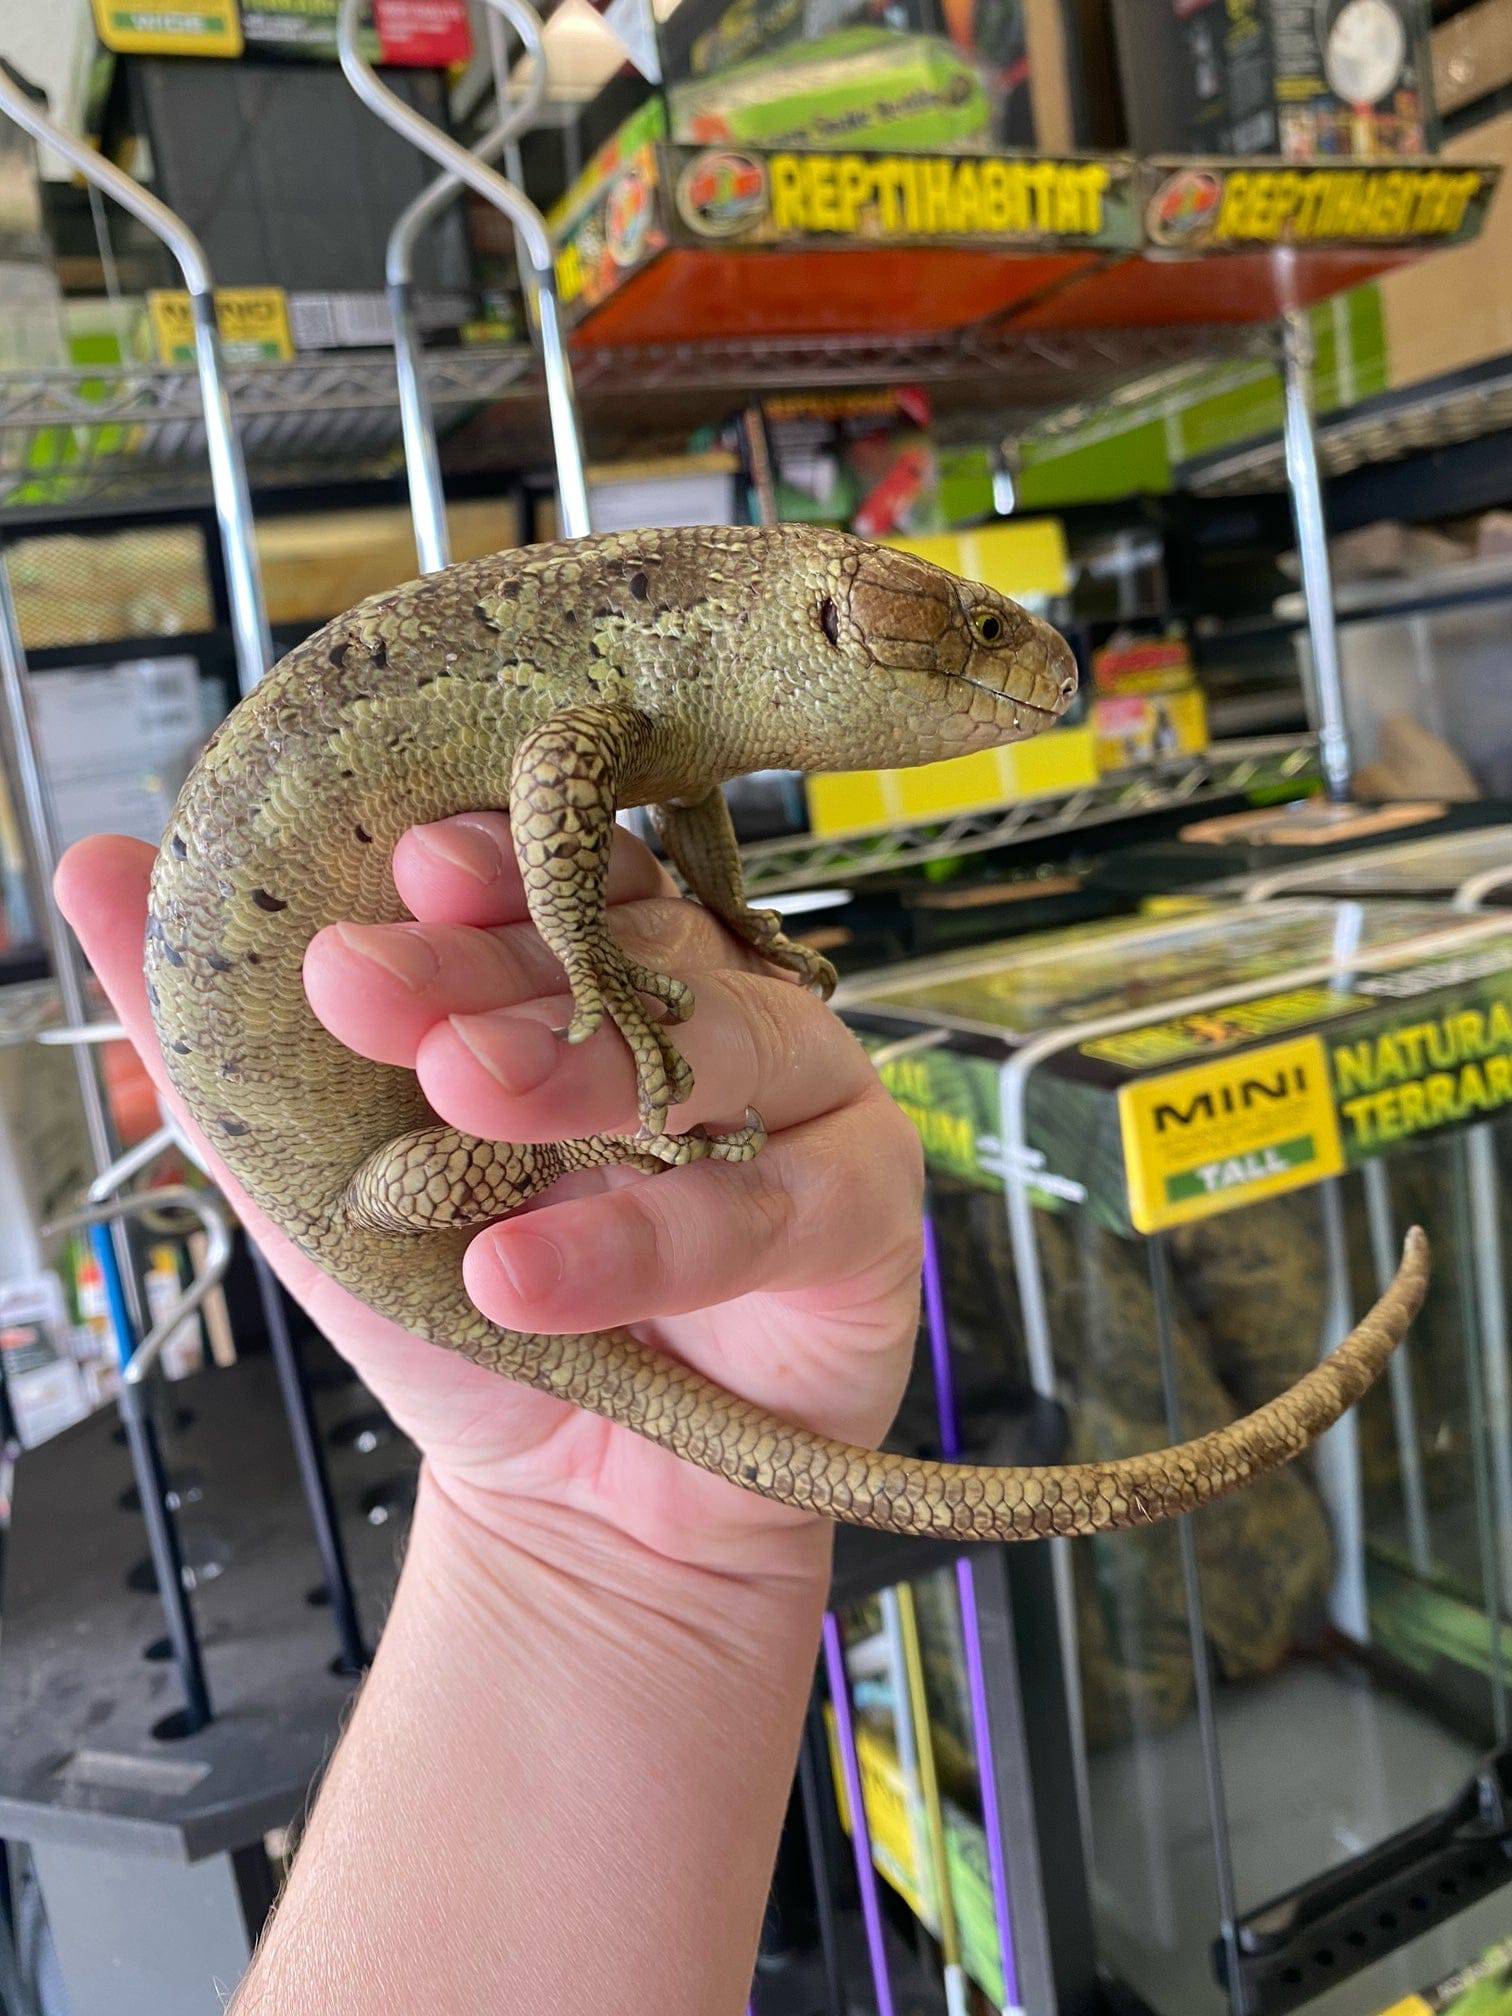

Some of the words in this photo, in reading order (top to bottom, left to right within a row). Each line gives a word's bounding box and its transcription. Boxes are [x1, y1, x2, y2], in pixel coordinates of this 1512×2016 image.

[771, 153, 1109, 236] REPTIHABITAT
[1154, 1064, 1307, 1135] MINI
[1197, 1144, 1290, 1192] TALL
